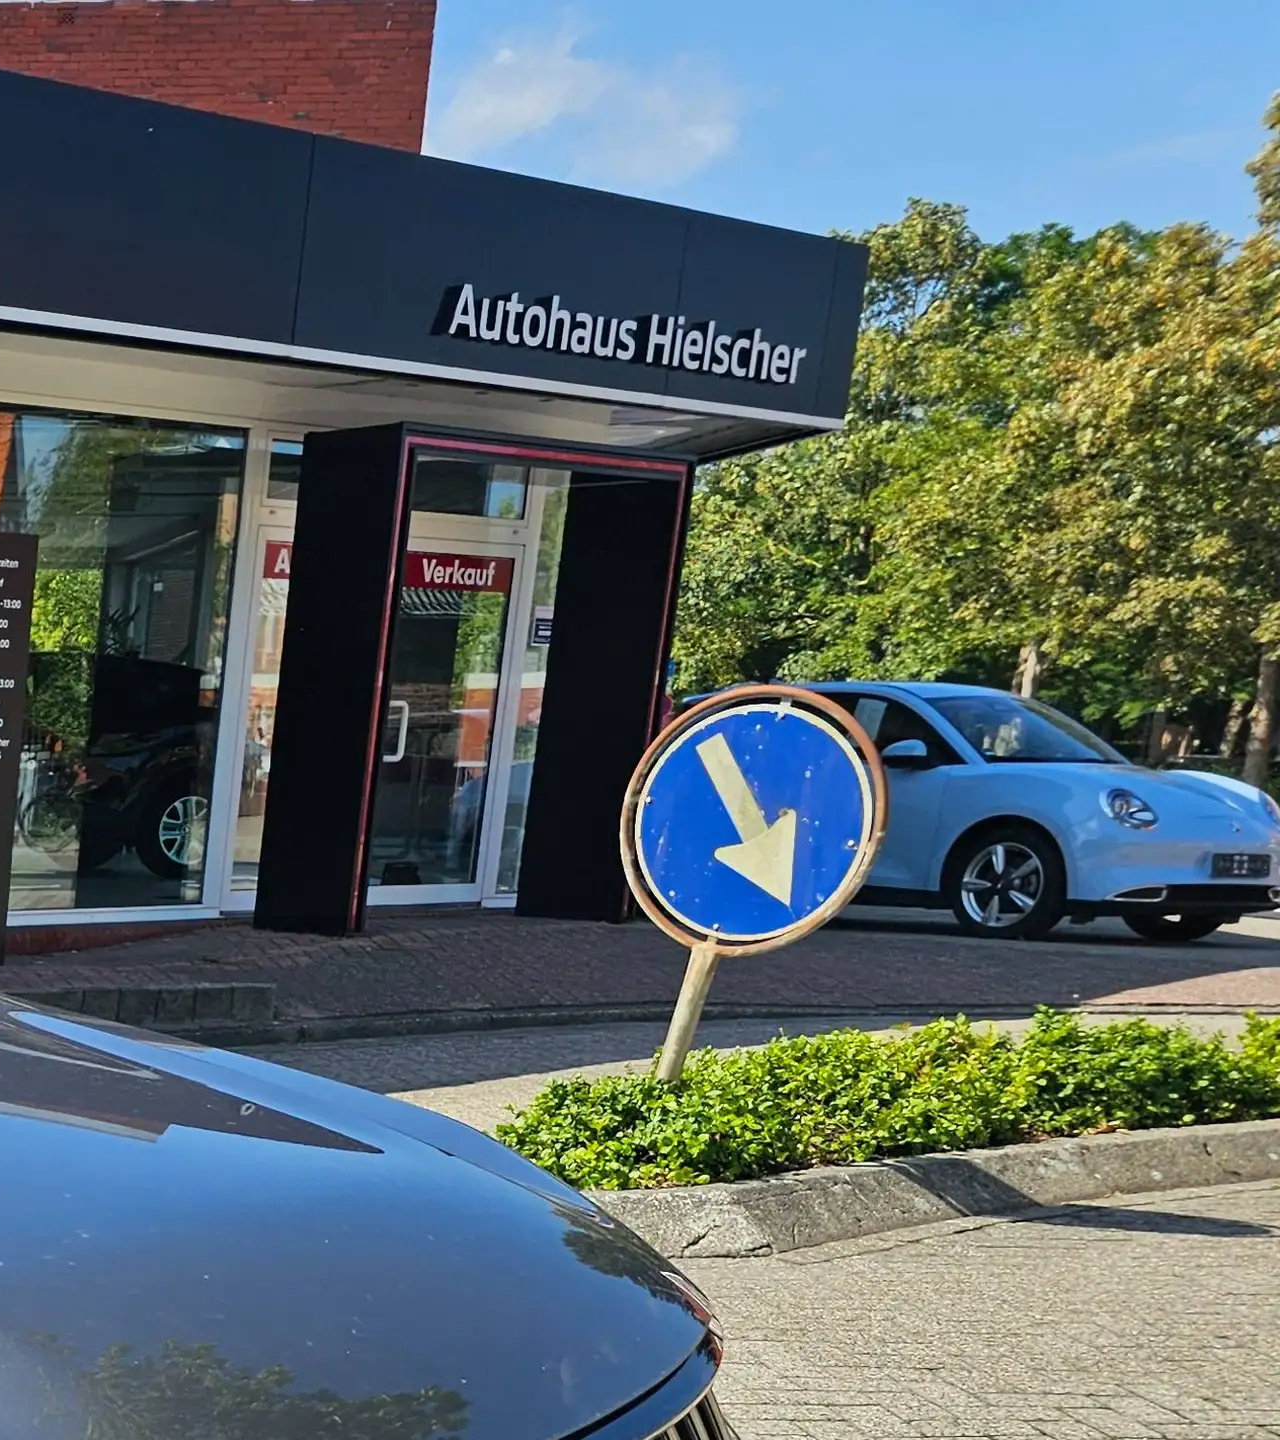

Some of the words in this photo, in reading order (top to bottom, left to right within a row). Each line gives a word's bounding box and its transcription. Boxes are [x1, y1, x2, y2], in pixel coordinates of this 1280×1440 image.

[448, 283, 638, 361] Autohaus
[645, 313, 807, 385] Hielscher
[422, 557, 496, 586] Verkauf
